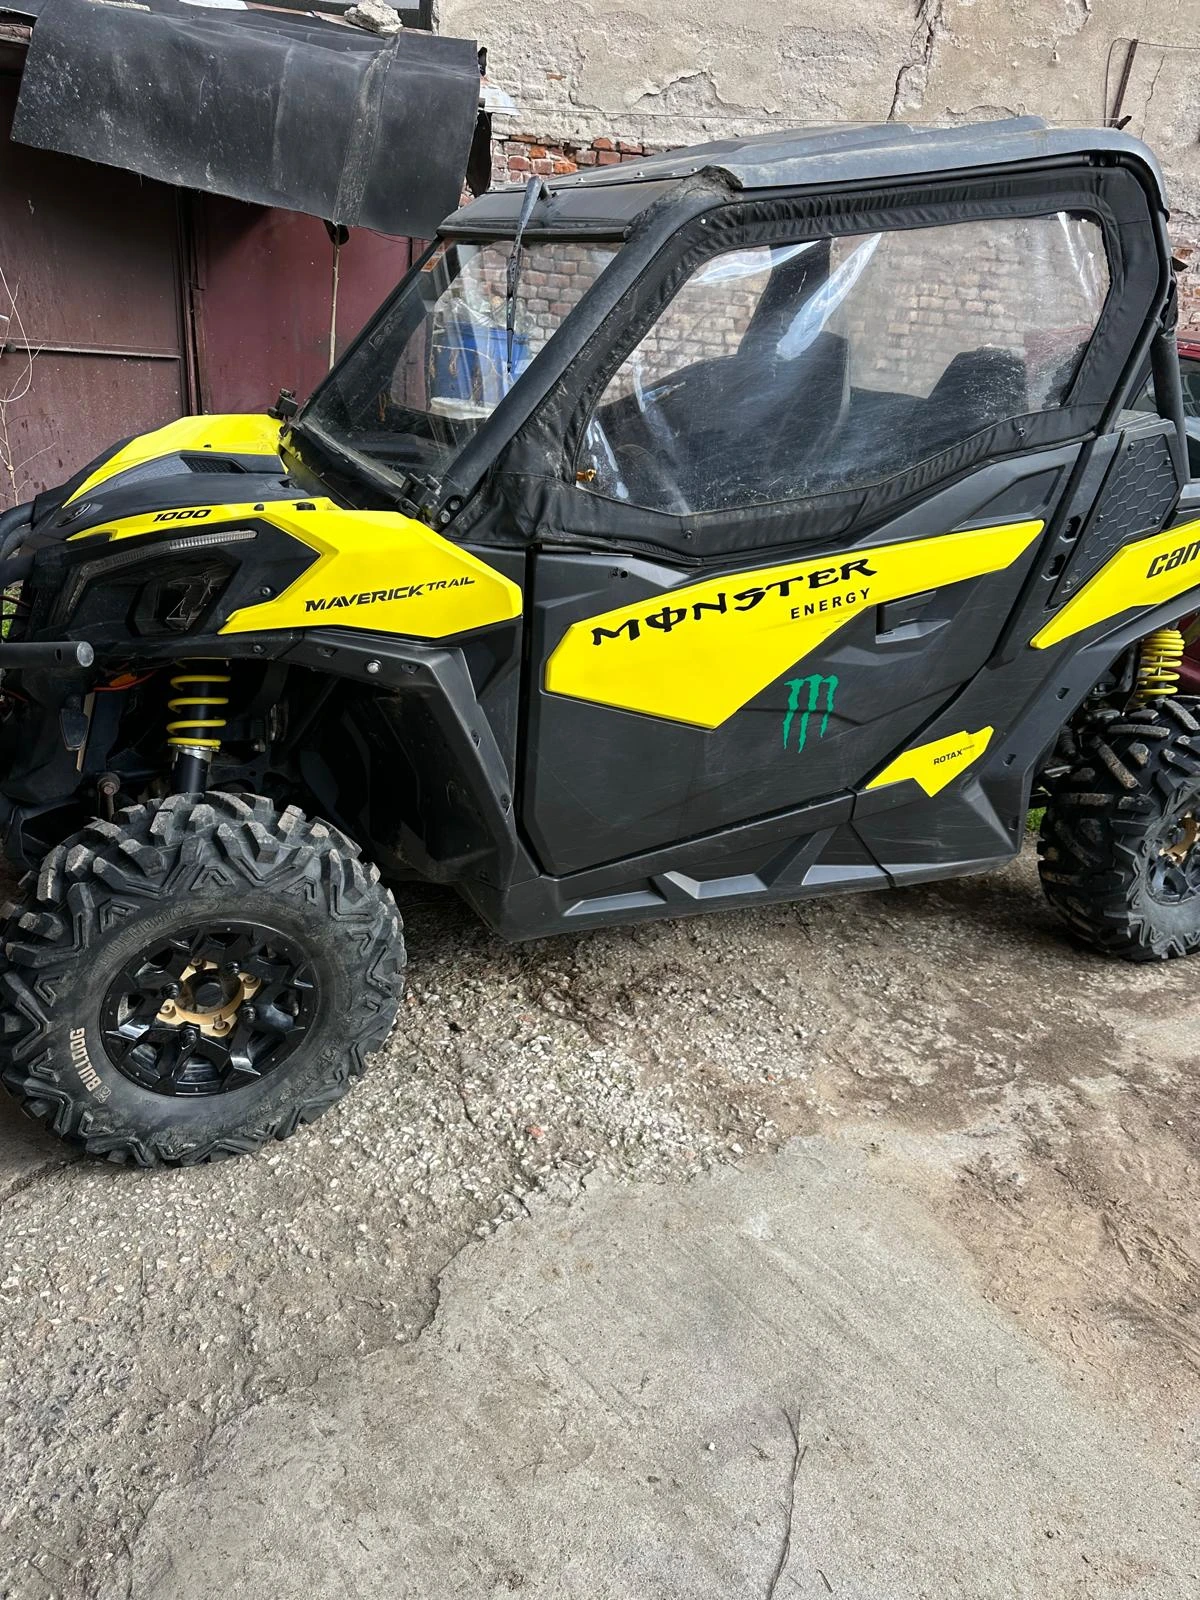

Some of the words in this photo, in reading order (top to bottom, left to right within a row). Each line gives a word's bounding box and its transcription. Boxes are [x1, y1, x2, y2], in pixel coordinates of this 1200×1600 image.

[153, 509, 212, 523] 1000
[305, 583, 424, 613] MAVERICK
[426, 576, 476, 592] TRAIL
[592, 558, 878, 646] MONSTER
[790, 587, 870, 620] ENERGY
[933, 749, 963, 765] ROTAX
[69, 1026, 103, 1092] BULLDOG
